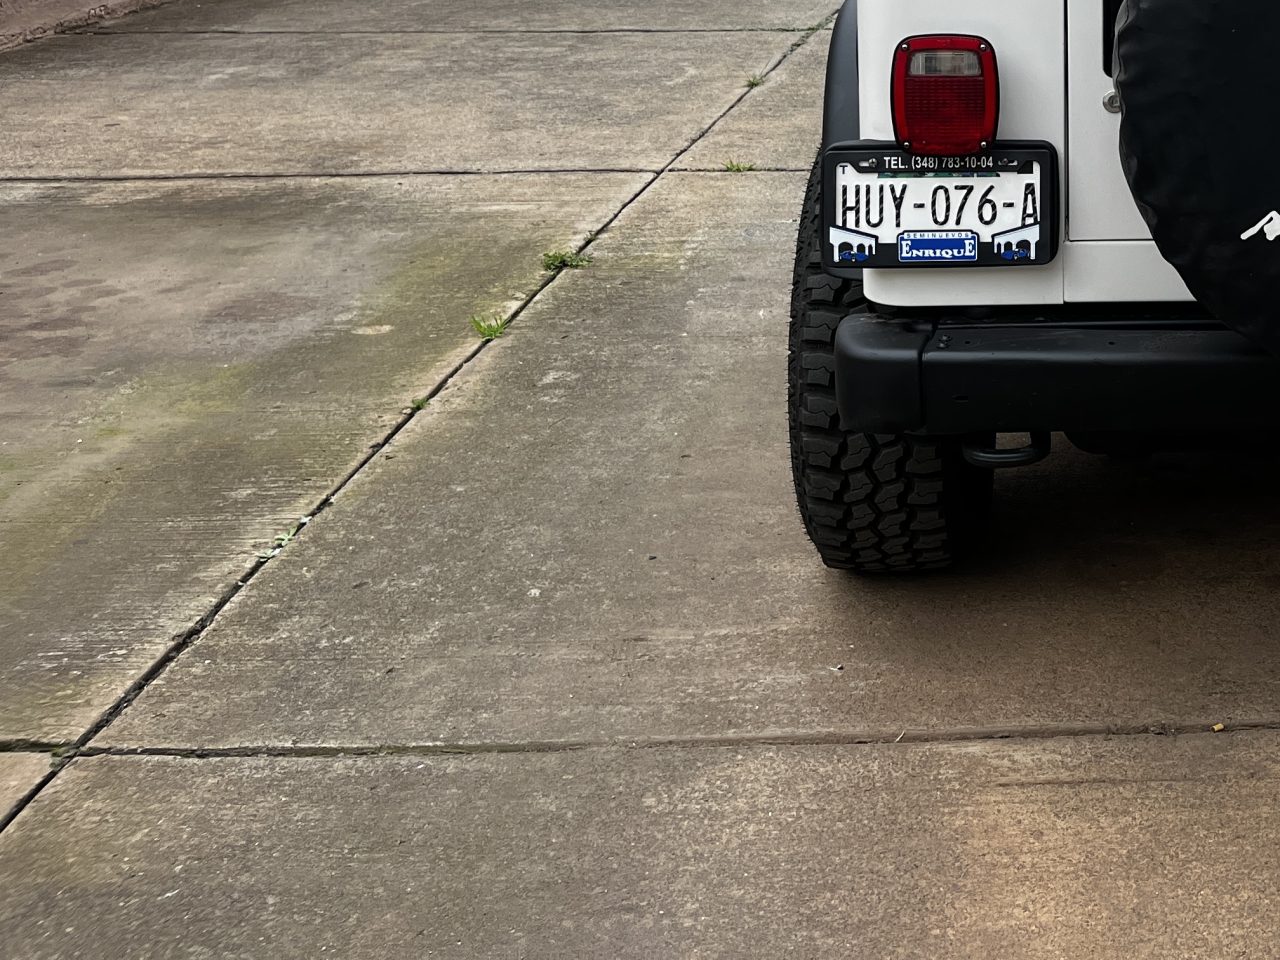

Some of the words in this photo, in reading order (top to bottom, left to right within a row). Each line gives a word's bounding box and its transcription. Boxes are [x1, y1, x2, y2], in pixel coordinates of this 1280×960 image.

[884, 157, 909, 169] TEL.
[911, 156, 938, 170] (348)
[942, 156, 994, 169] 783-10-04
[841, 182, 1040, 228] HUY-076-A
[901, 240, 975, 258] ENRIQUE
